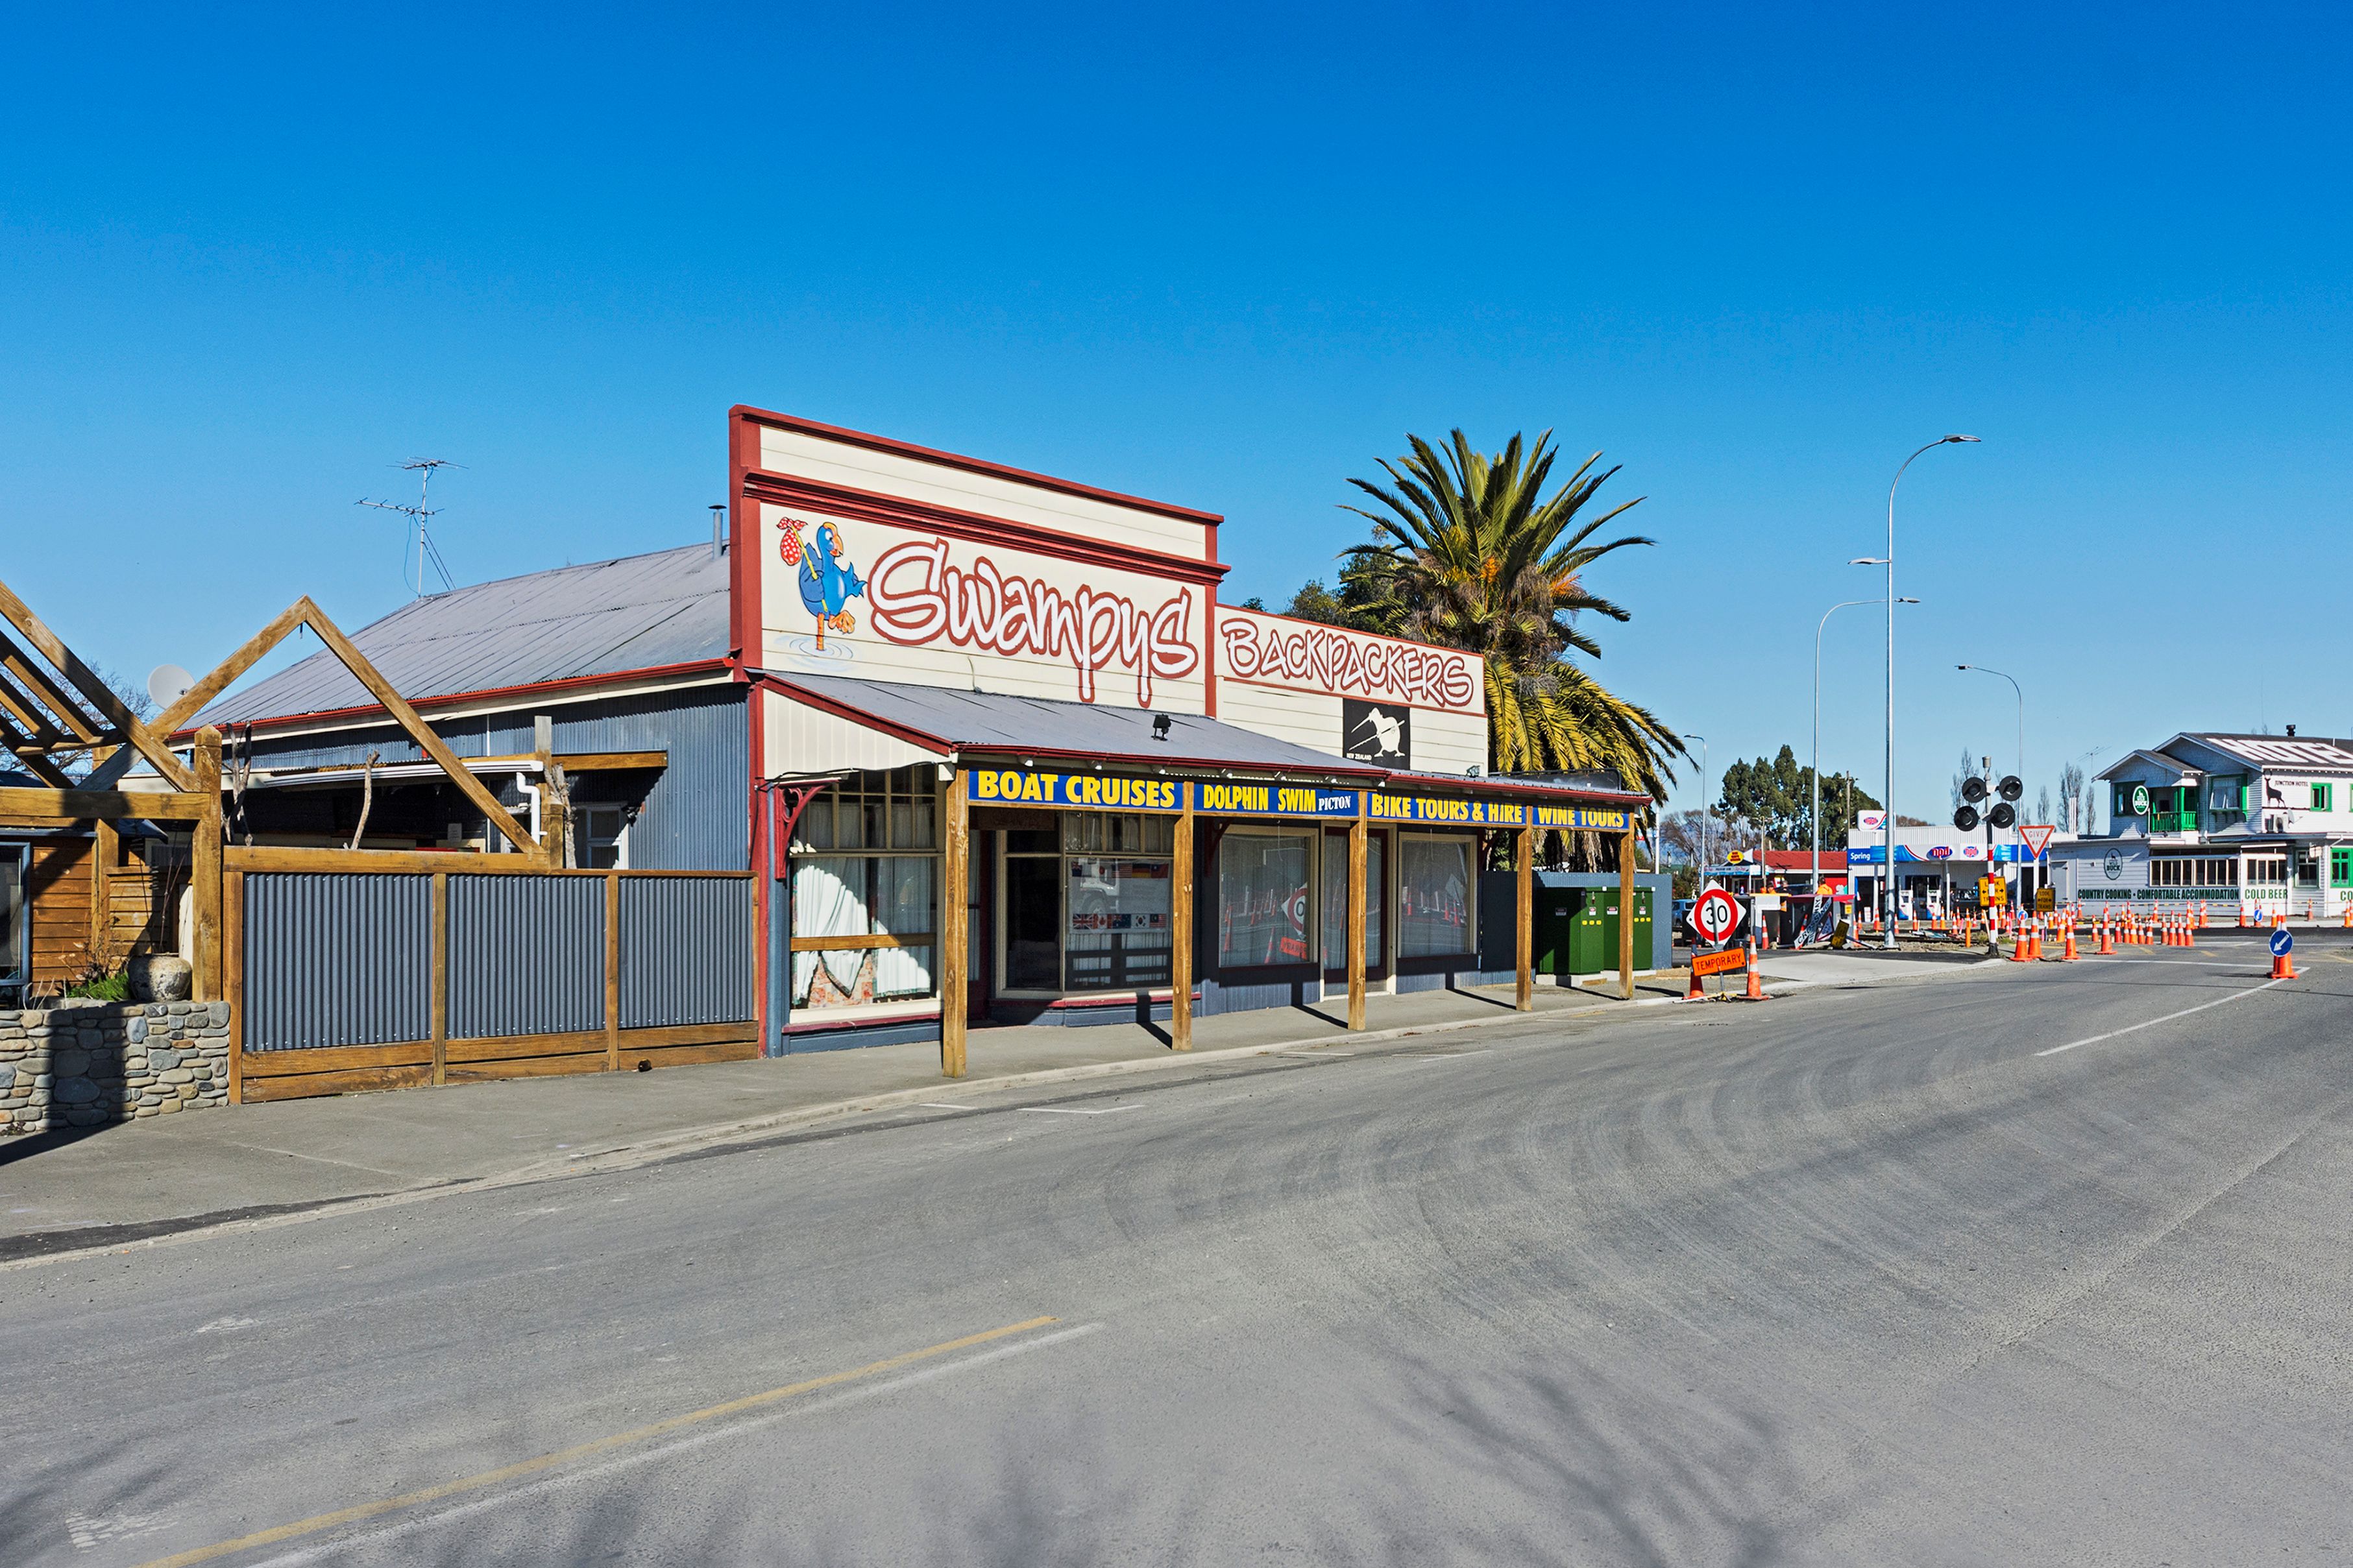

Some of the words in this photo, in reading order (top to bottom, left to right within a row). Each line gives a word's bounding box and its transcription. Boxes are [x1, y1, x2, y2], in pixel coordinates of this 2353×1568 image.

[869, 537, 1199, 708] Swampys
[1221, 618, 1474, 708] BACKPACKERS
[978, 771, 1058, 801] BOAT
[1066, 776, 1175, 808] CRUISES
[1204, 784, 1269, 811] DOLPHIN
[1278, 788, 1317, 812] SWIM
[1319, 795, 1351, 811] PICTON
[1372, 793, 1411, 818] BIKE
[1416, 798, 1469, 821] TOURS
[1472, 802, 1484, 822] &
[1488, 803, 1522, 824] HIRE
[1538, 805, 1576, 826] WINE
[1579, 808, 1624, 828] TOURS
[1850, 852, 1870, 861] Spring
[2078, 889, 2104, 899] COUNTRY
[2105, 889, 2131, 900] COOKING
[2137, 889, 2180, 900] COMFORTABLE
[2181, 889, 2239, 900] ACCOMMODATION
[2245, 889, 2265, 899] COLD
[2268, 889, 2288, 899] BEER
[1705, 905, 1727, 925] 30
[1696, 953, 1742, 971] TEMPORARY
